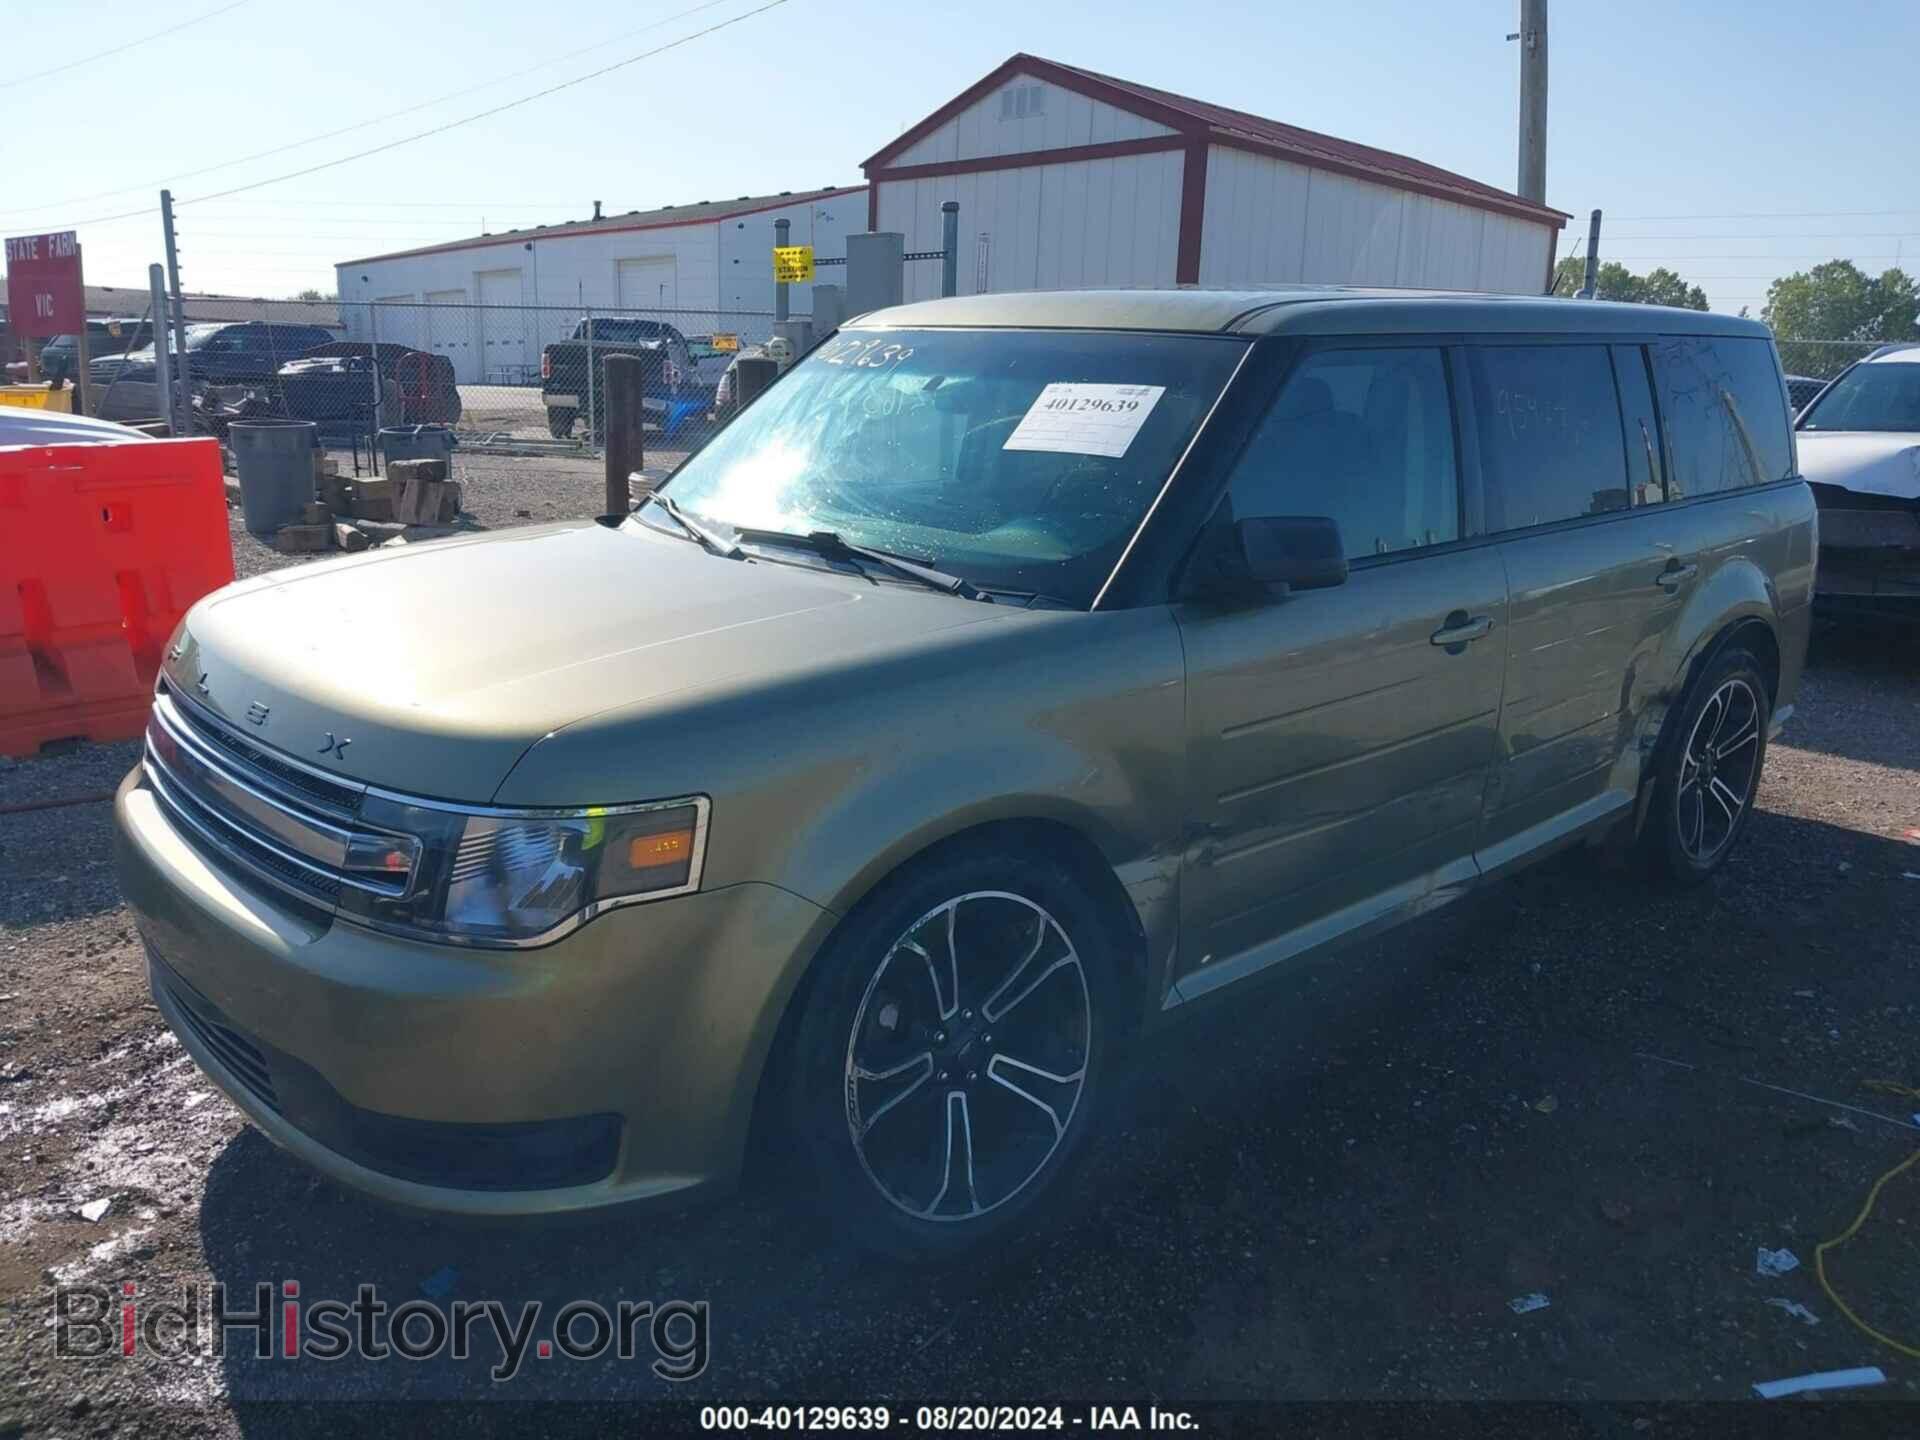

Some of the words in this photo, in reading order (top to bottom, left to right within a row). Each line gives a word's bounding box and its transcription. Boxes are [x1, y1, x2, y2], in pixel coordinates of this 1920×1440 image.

[6, 238, 39, 262] STATE
[48, 232, 76, 258] FARM
[35, 293, 54, 318] VIC
[1044, 398, 1140, 413] 40129639
